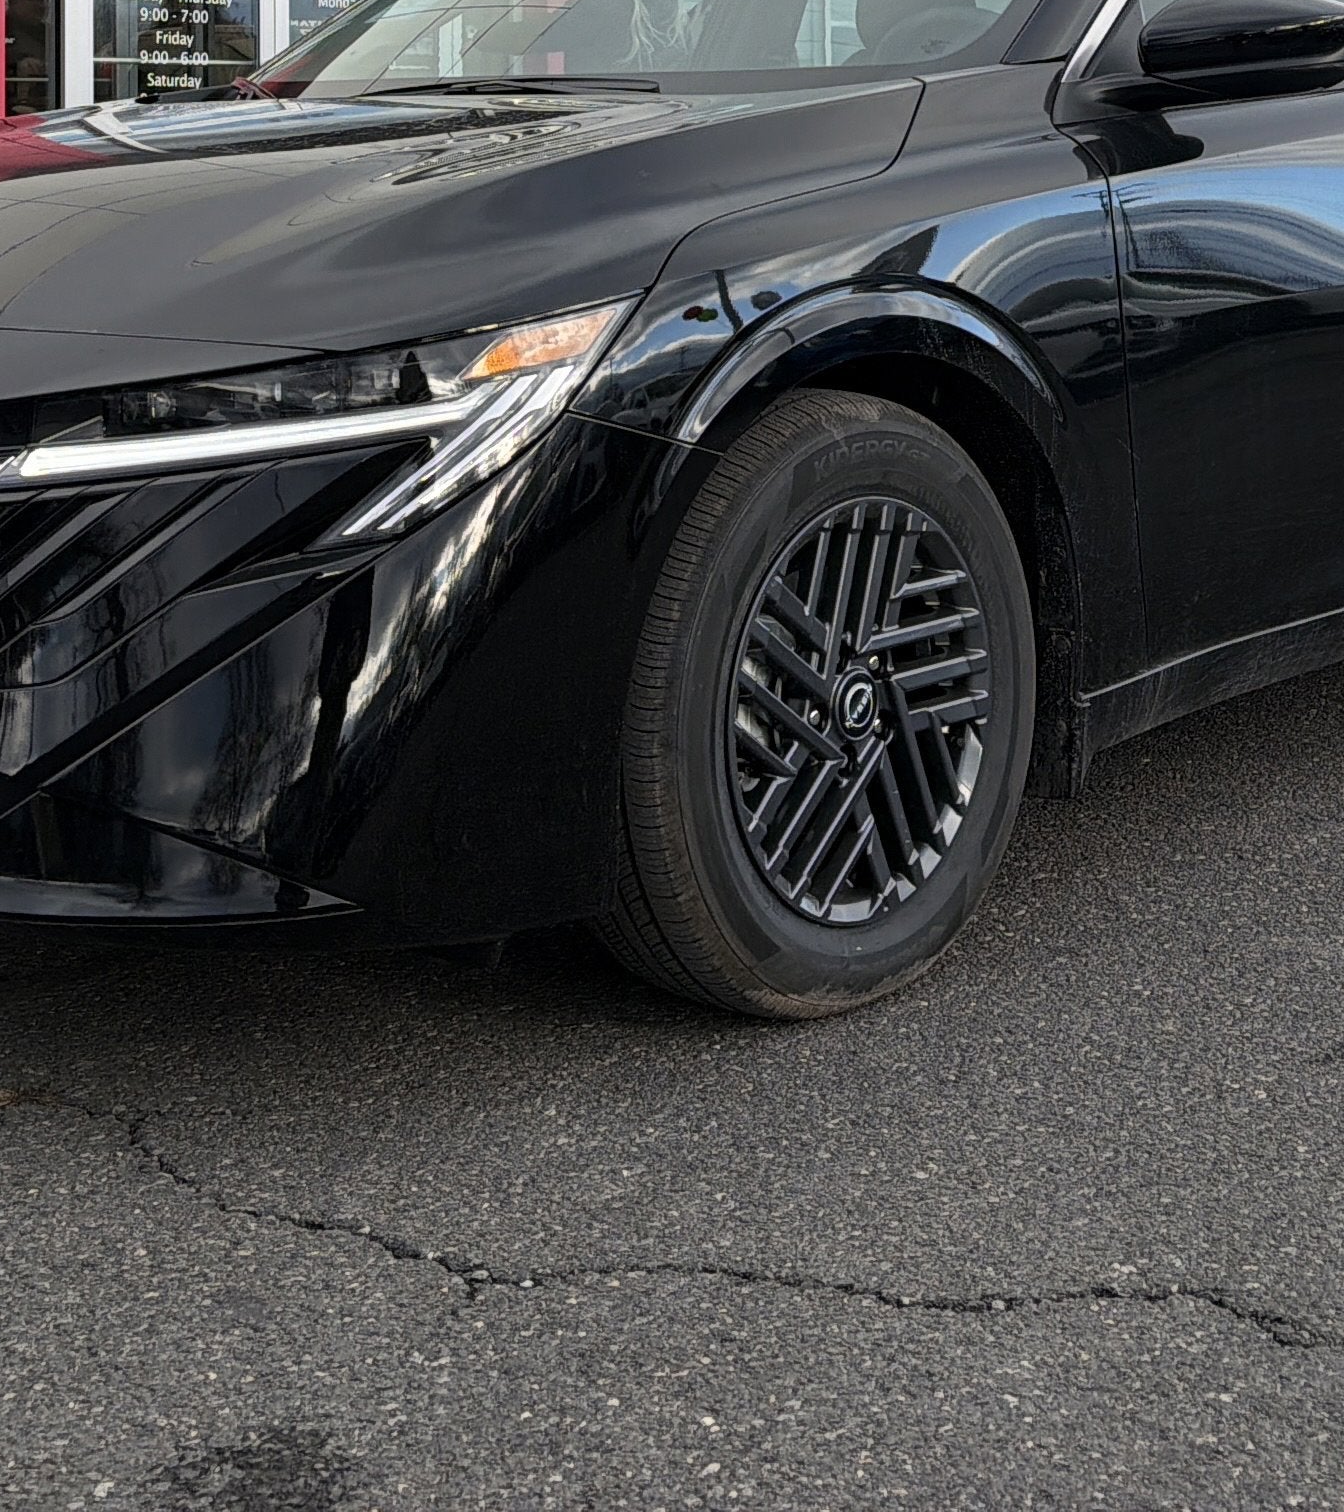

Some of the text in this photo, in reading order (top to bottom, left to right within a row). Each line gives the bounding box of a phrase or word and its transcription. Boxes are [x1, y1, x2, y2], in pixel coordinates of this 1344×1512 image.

[140, 7, 169, 22] 9:00
[181, 9, 209, 24] 7:00
[155, 30, 195, 48] Friday
[140, 50, 169, 65] 9:00
[181, 51, 209, 66] 6:00
[146, 73, 203, 89] Saturday
